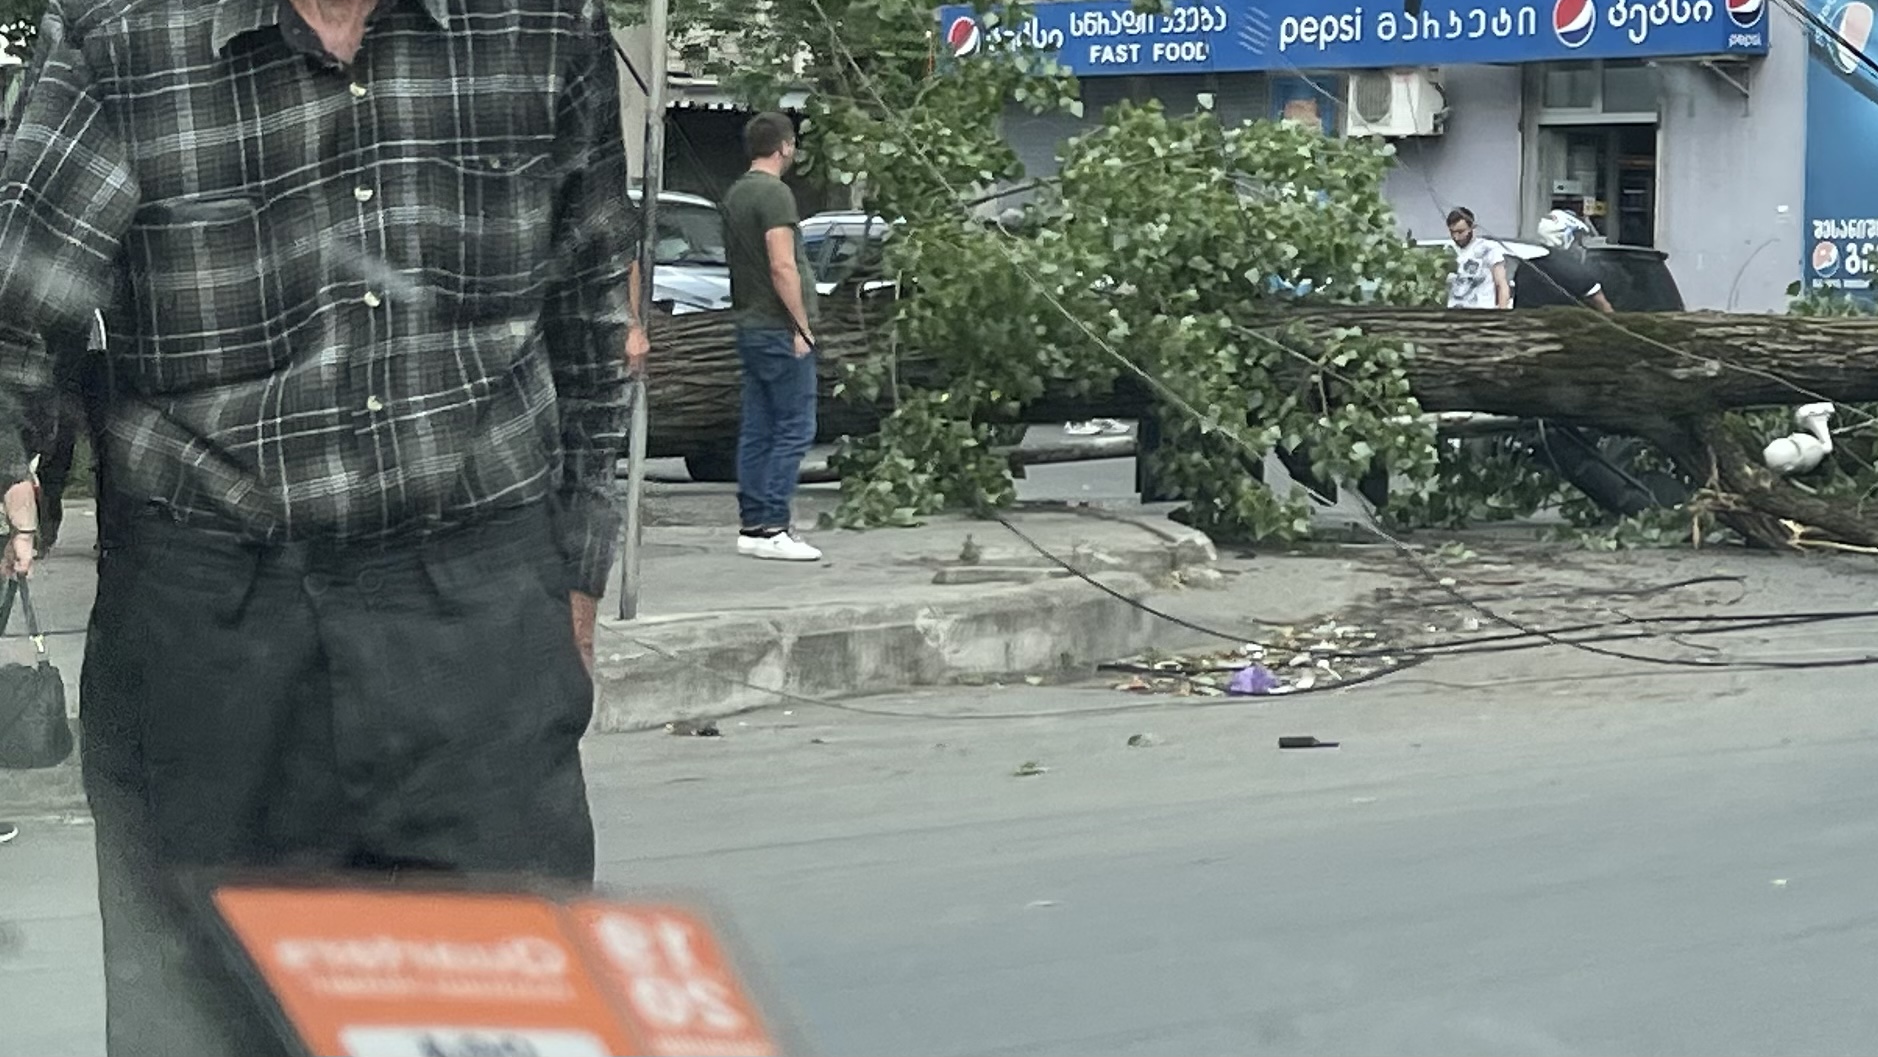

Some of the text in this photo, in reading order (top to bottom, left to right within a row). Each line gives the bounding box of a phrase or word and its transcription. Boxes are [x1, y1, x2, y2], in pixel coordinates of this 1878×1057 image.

[1278, 6, 1363, 52] pepsi
[1089, 41, 1210, 64] FAST FOOD
